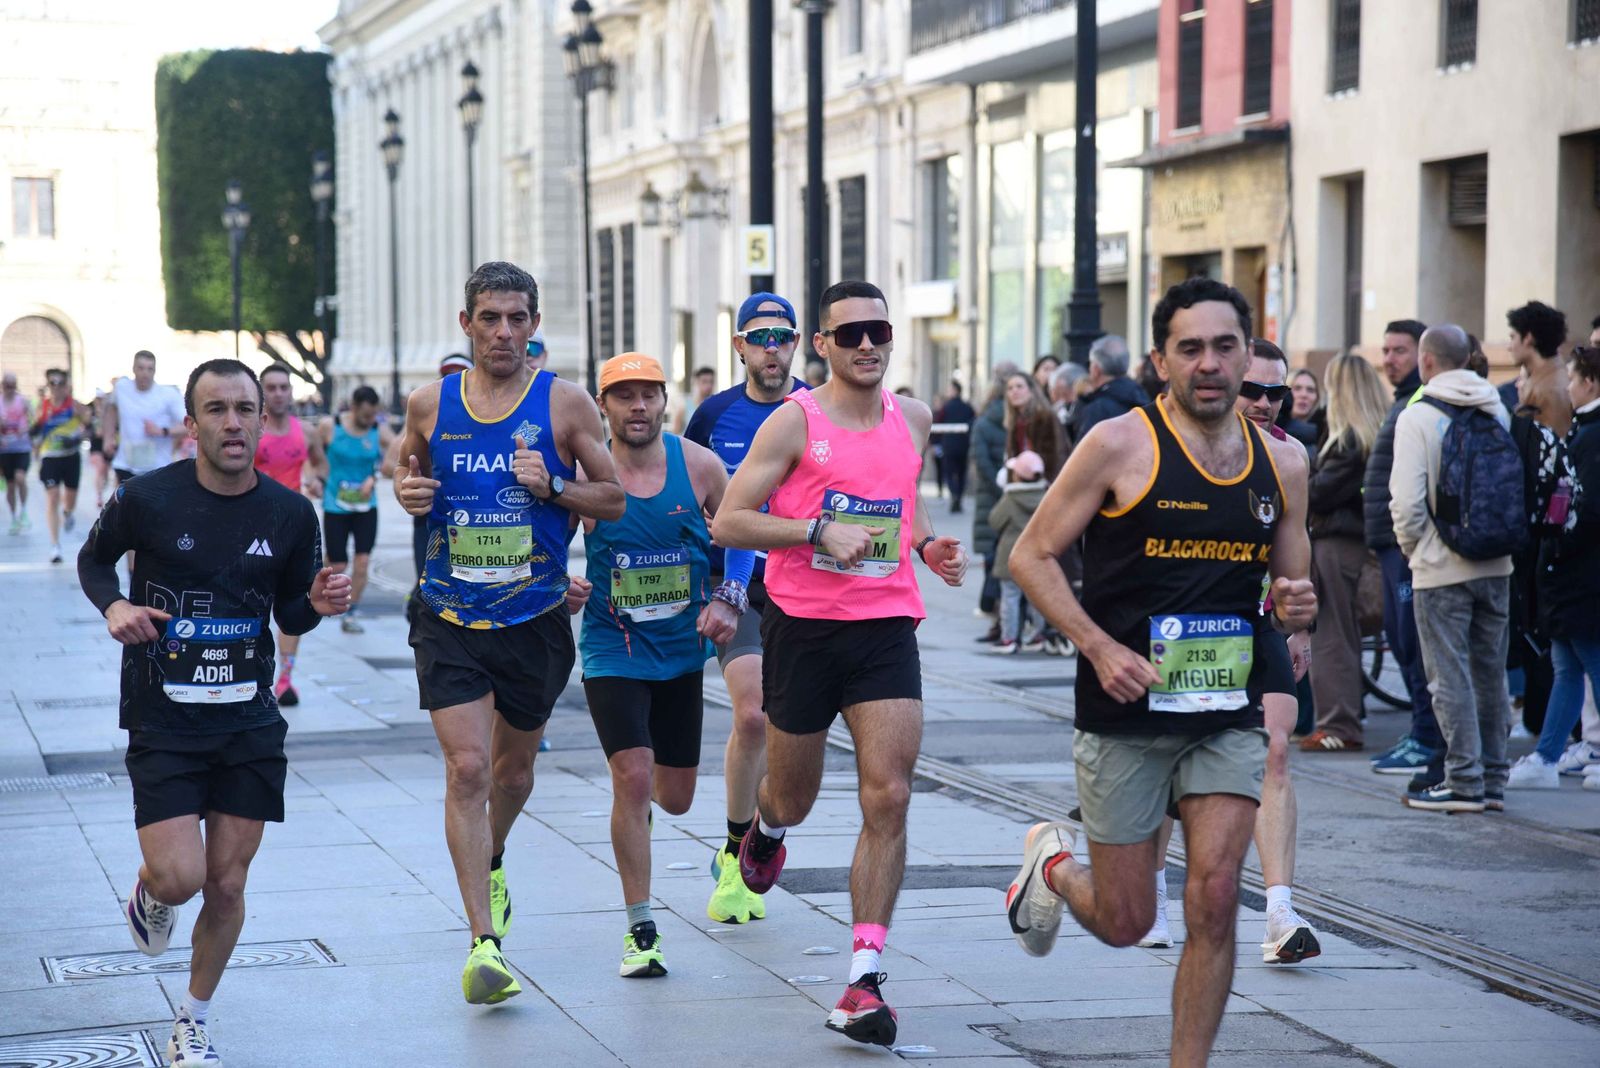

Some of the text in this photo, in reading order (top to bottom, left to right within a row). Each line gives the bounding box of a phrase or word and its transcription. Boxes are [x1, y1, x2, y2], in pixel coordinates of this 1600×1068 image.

[751, 238, 765, 262] 5
[854, 500, 899, 514] ZURICH
[474, 513, 521, 523] ZURICH
[476, 536, 502, 545] 1714
[1145, 537, 1256, 561] BLACKROCK
[450, 553, 483, 566] PEDRO
[635, 553, 681, 565] ZURICH
[637, 575, 662, 585] 1797
[612, 589, 690, 607] VITOR PARADA
[201, 623, 251, 636] ZURICH
[1187, 618, 1241, 634] ZURICH
[201, 648, 228, 661] 4693
[1186, 649, 1217, 663] 2130
[192, 664, 234, 683] ADRI
[1168, 669, 1236, 691] MIGUEL
